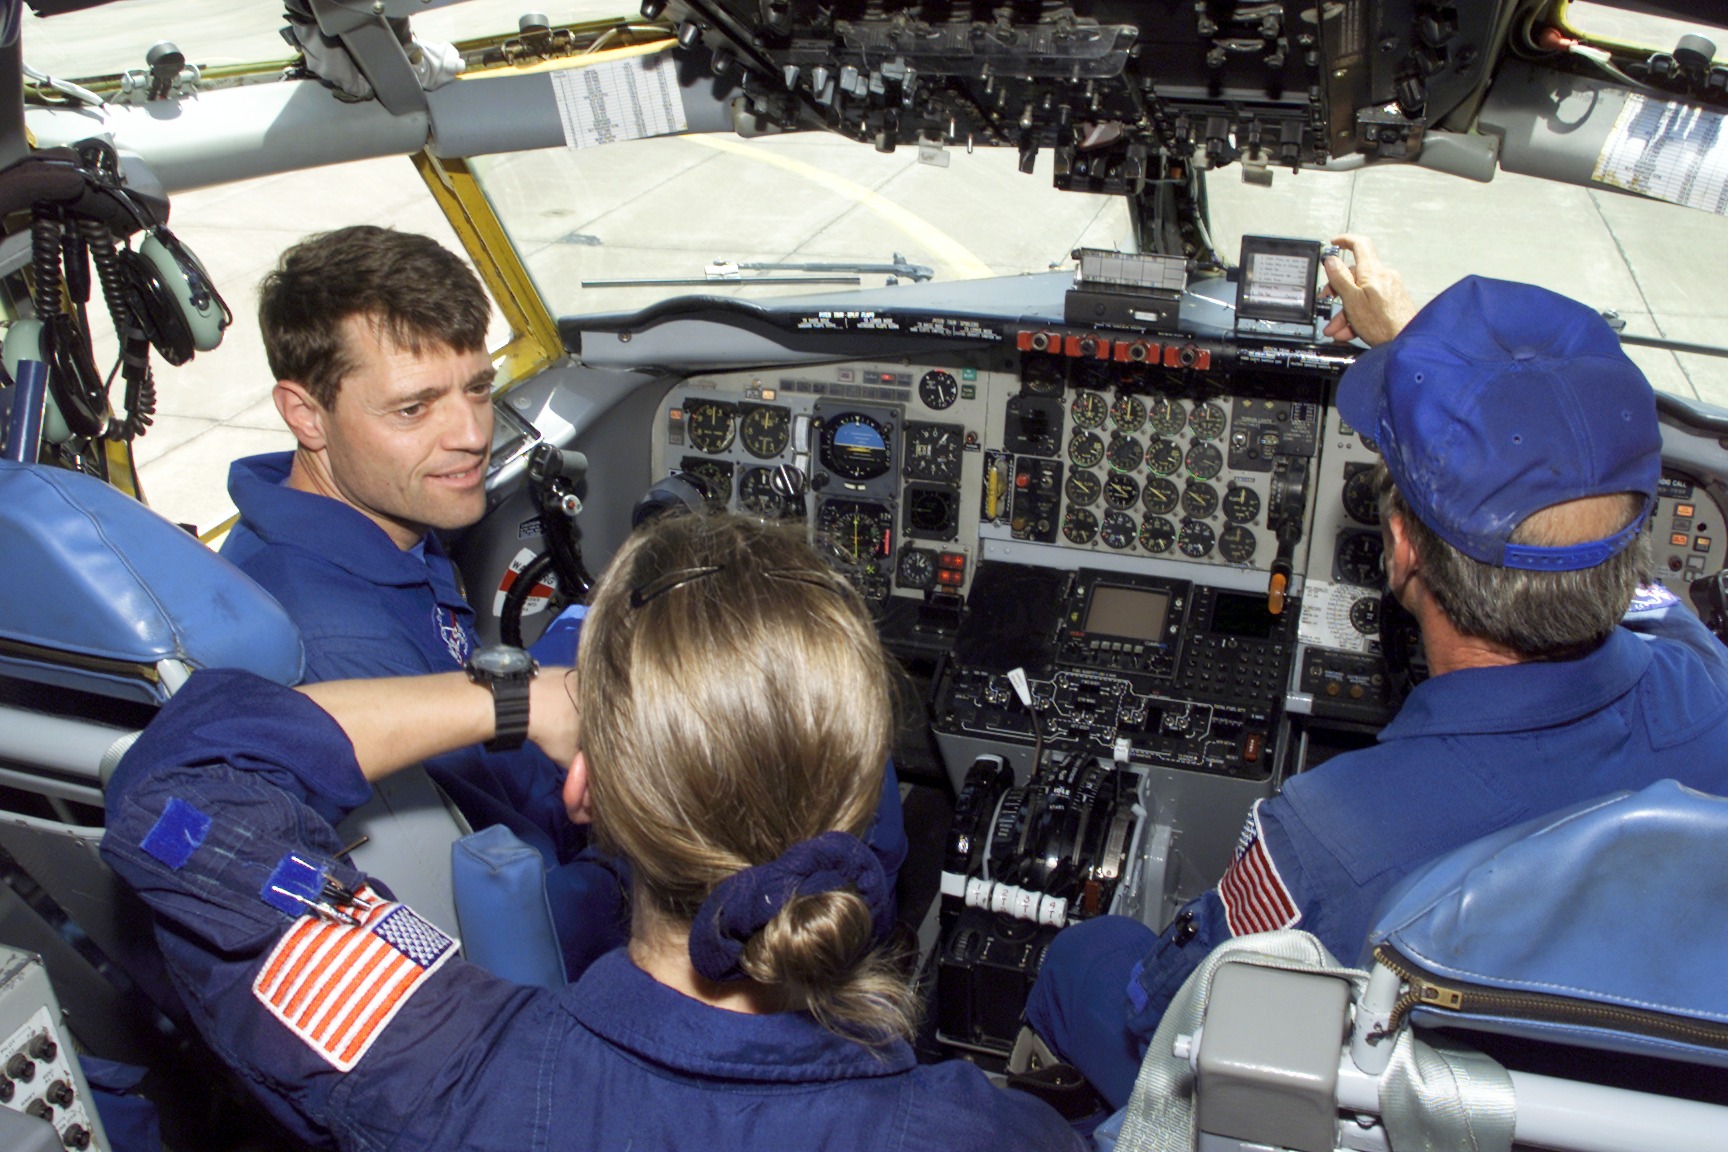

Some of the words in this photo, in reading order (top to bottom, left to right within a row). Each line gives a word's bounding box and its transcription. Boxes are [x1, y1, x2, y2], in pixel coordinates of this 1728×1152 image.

[512, 559, 555, 585] WANG
[1002, 888, 1009, 897] 2
[1023, 895, 1030, 903] 3
